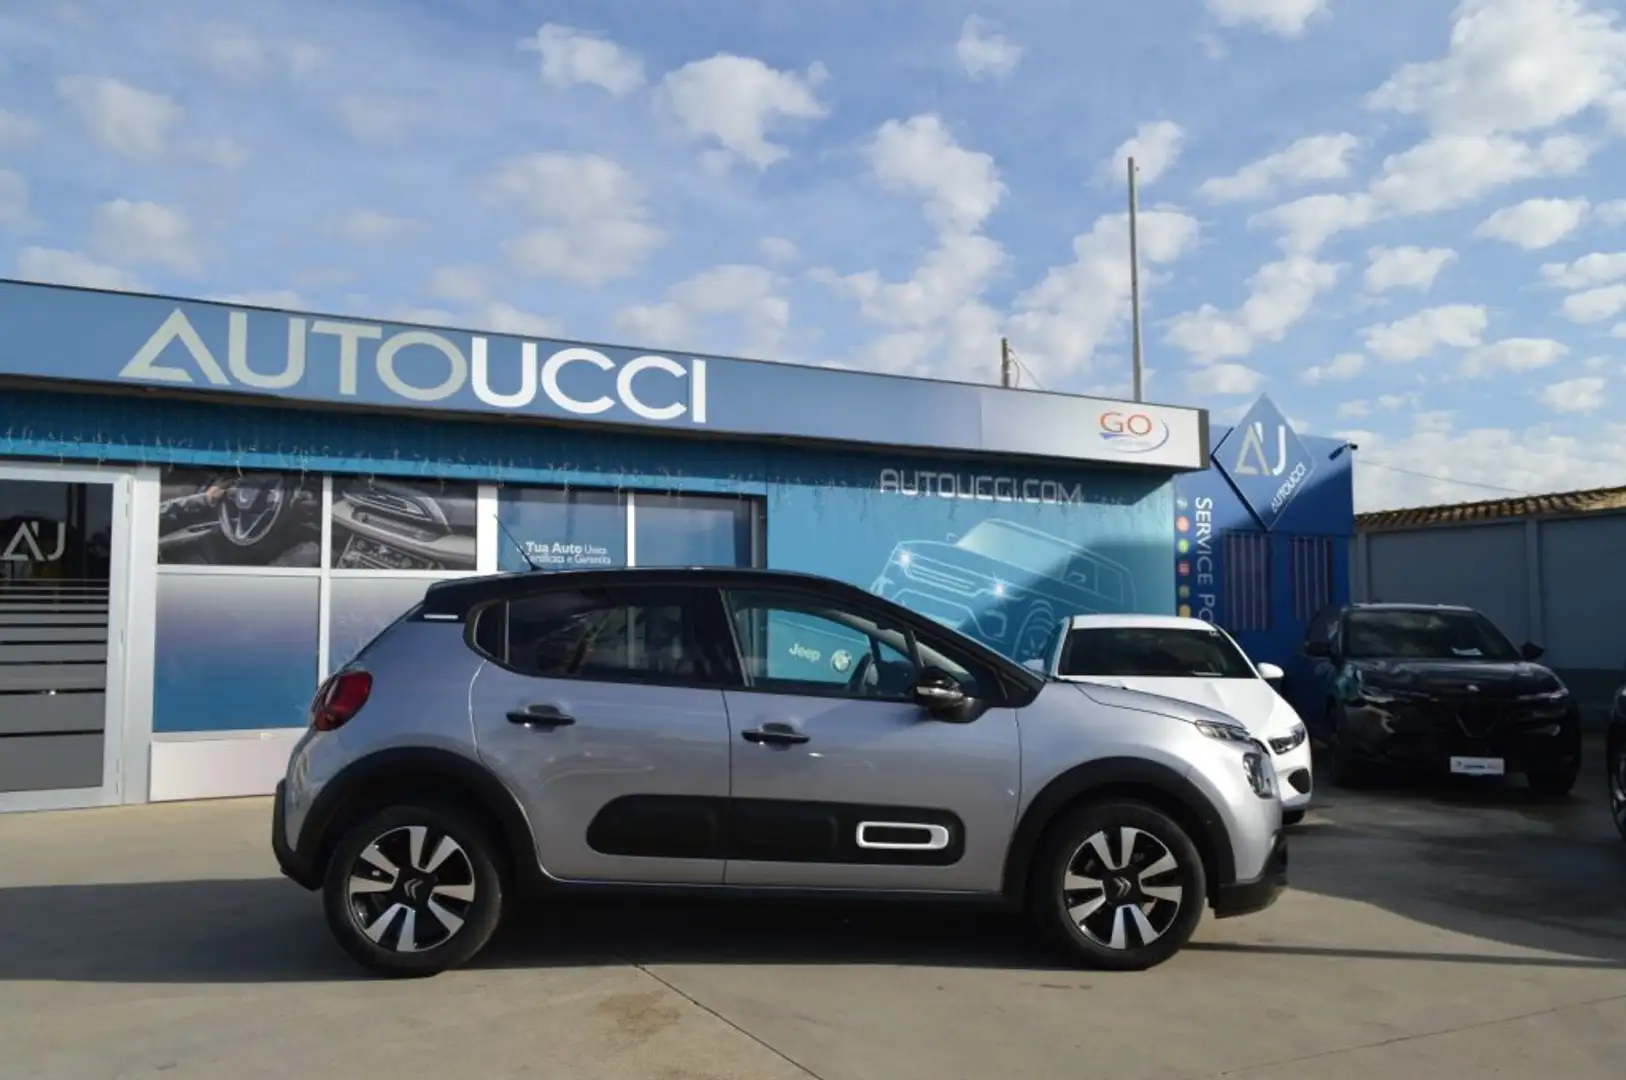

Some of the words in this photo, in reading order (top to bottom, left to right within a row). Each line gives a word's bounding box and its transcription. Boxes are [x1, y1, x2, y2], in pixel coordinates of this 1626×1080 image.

[117, 307, 706, 424] AUTOUCCI
[1099, 410, 1153, 436] GO
[879, 468, 1083, 506] AUTOUCCI.COM
[1270, 461, 1307, 514] AUTOUCCI
[525, 541, 549, 555] Tua
[551, 542, 583, 555] Auto
[1194, 496, 1214, 586] SERVICE
[787, 643, 821, 663] Jeep
